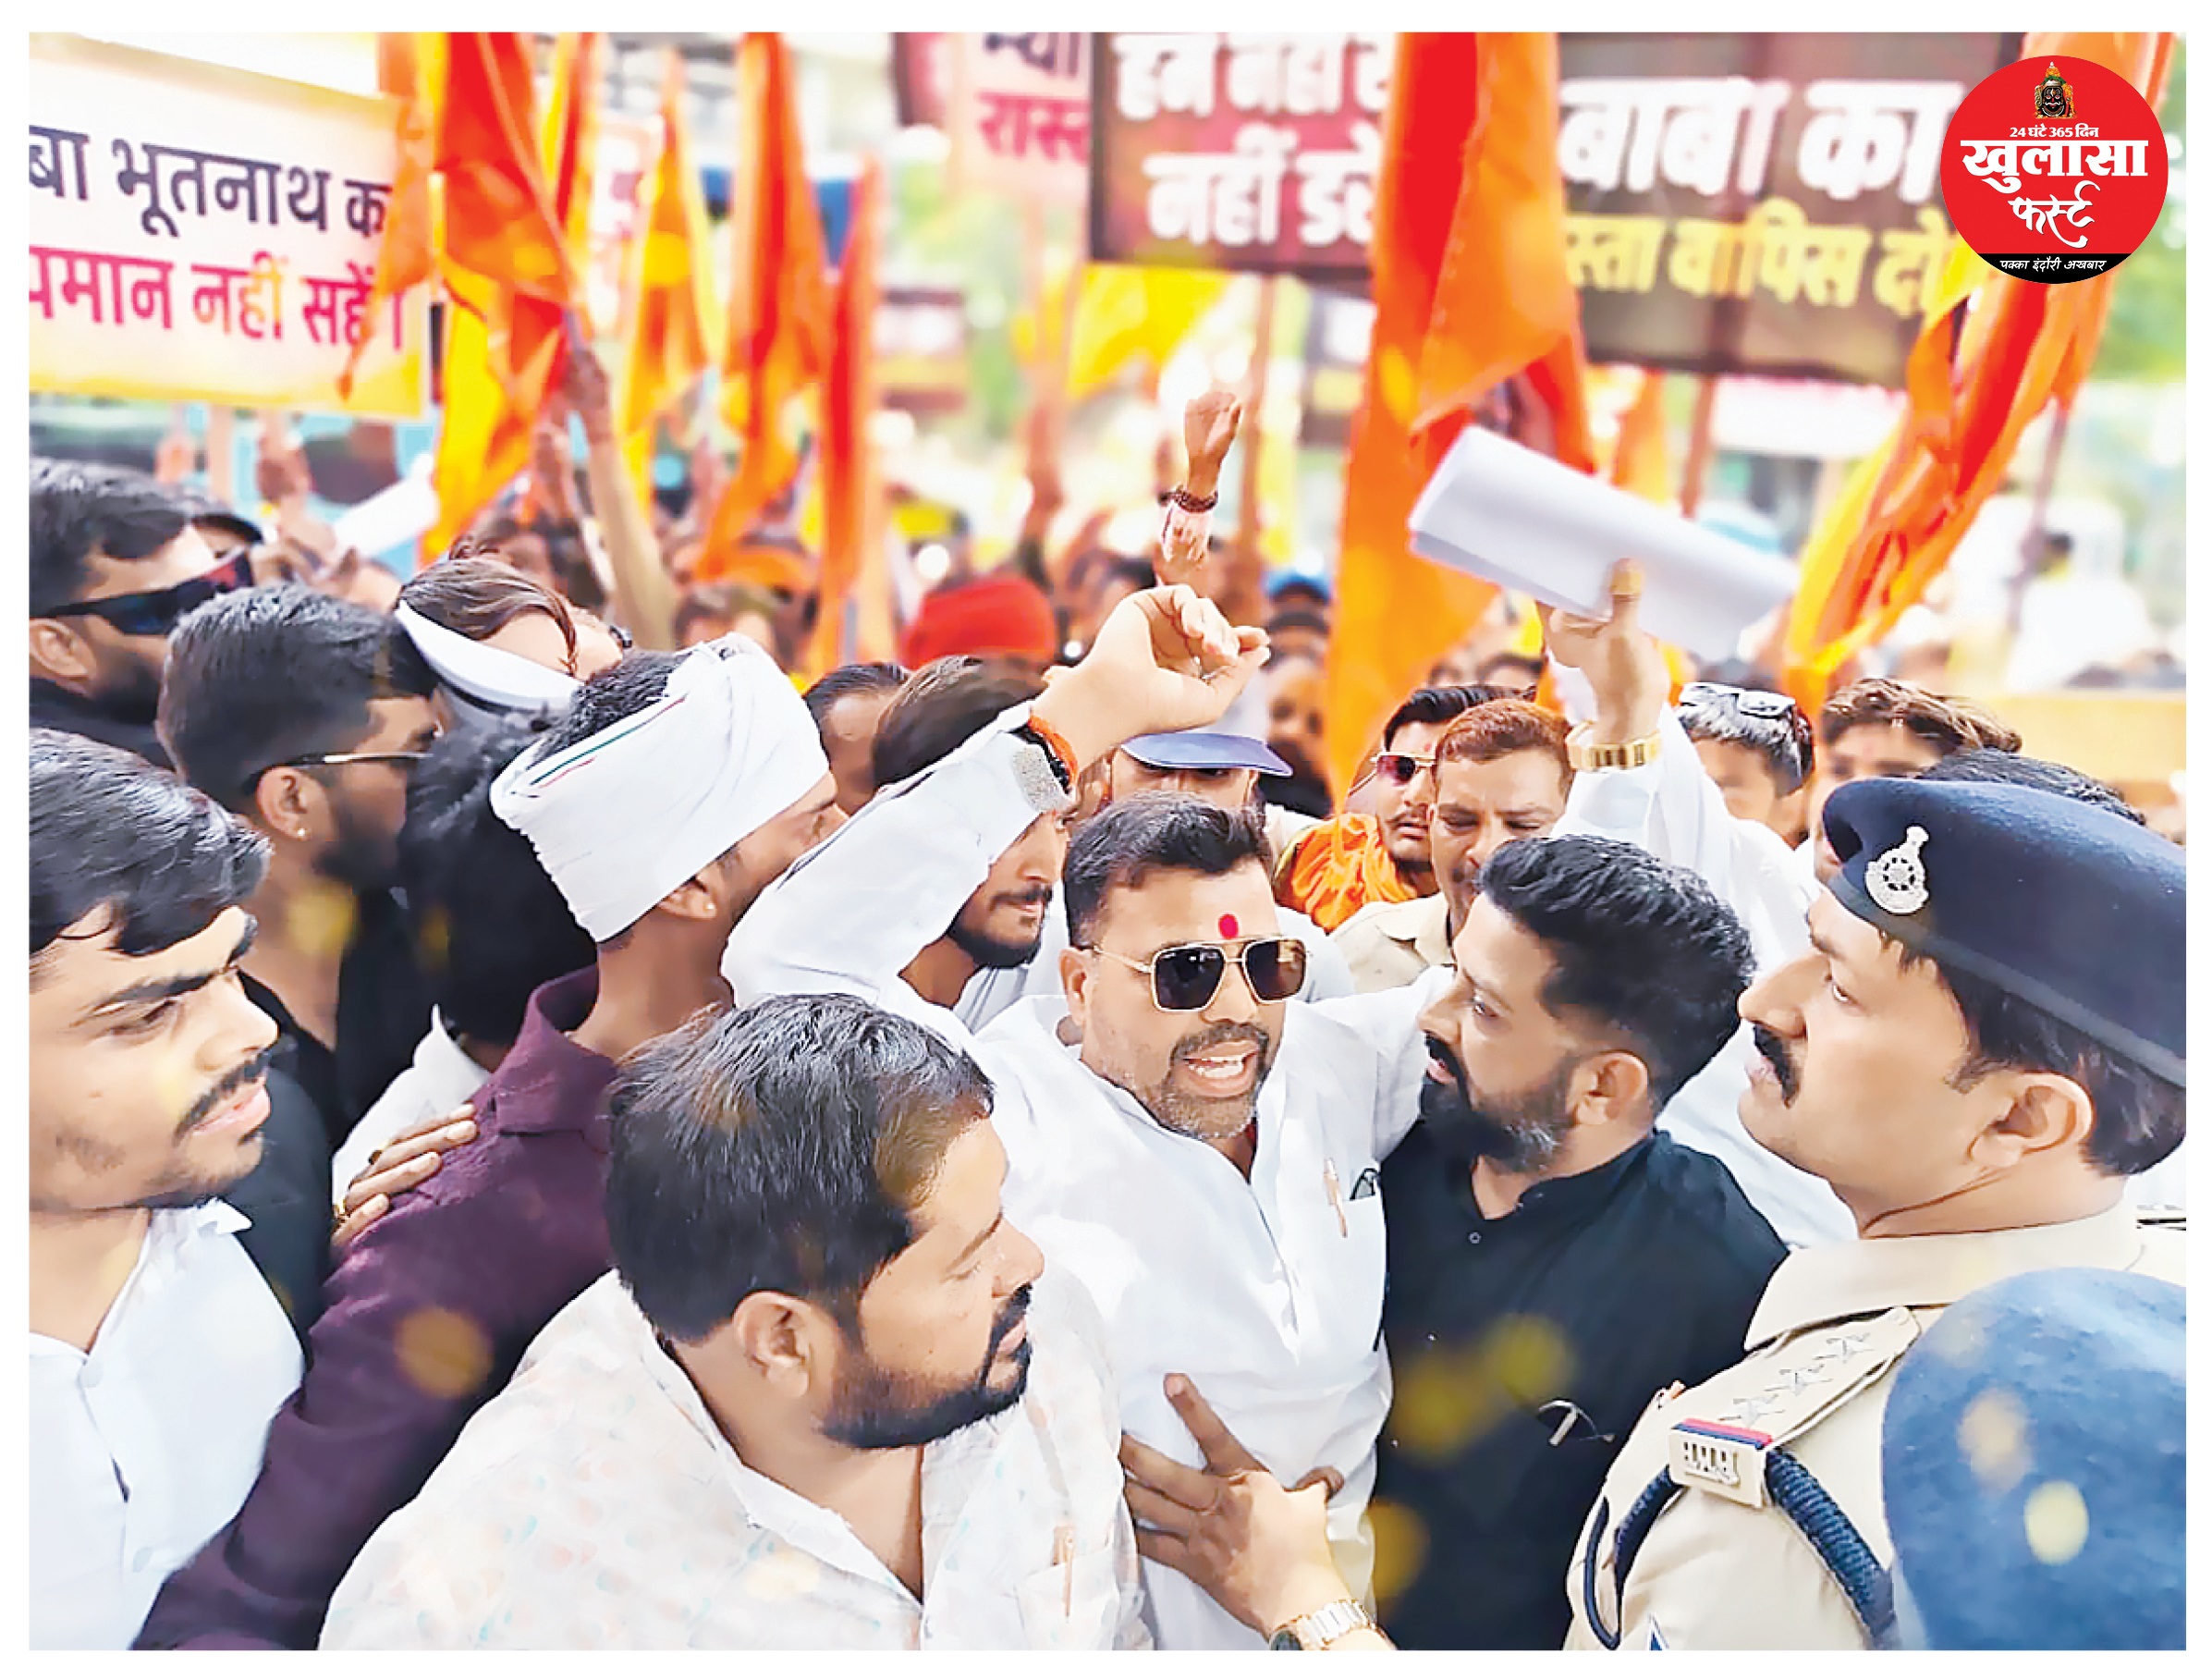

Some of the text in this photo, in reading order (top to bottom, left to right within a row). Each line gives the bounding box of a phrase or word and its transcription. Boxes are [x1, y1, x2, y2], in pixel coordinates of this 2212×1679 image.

[110, 137, 332, 238] भूतनाथ
[1558, 77, 1966, 203] बाबा का
[190, 251, 289, 340] नहीं
